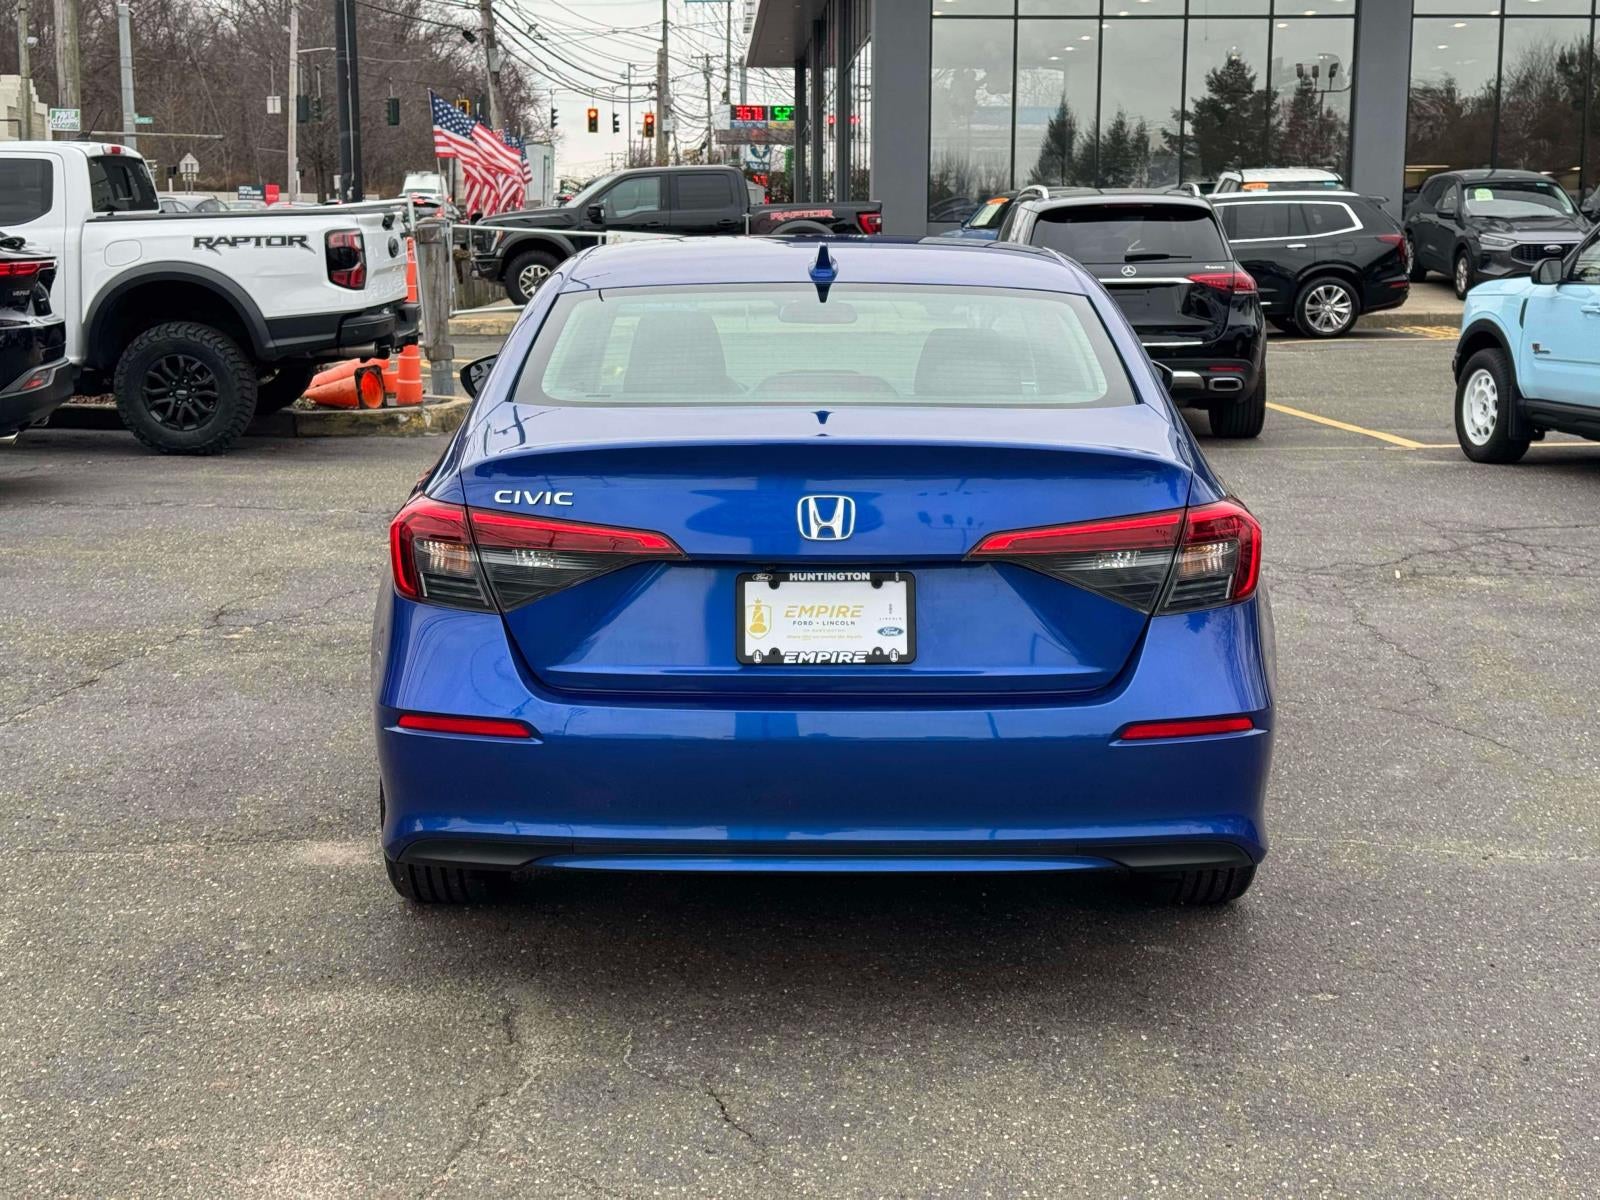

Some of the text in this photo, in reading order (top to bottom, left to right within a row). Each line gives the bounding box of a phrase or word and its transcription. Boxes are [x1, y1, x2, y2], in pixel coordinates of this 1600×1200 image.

[770, 209, 835, 221] RAPTOR
[193, 235, 316, 256] RAPTOR
[494, 490, 573, 506] CIVIC
[789, 572, 871, 581] HUNTINGTON
[784, 604, 865, 618] EMPIRE
[783, 651, 869, 664] EMPIRE
